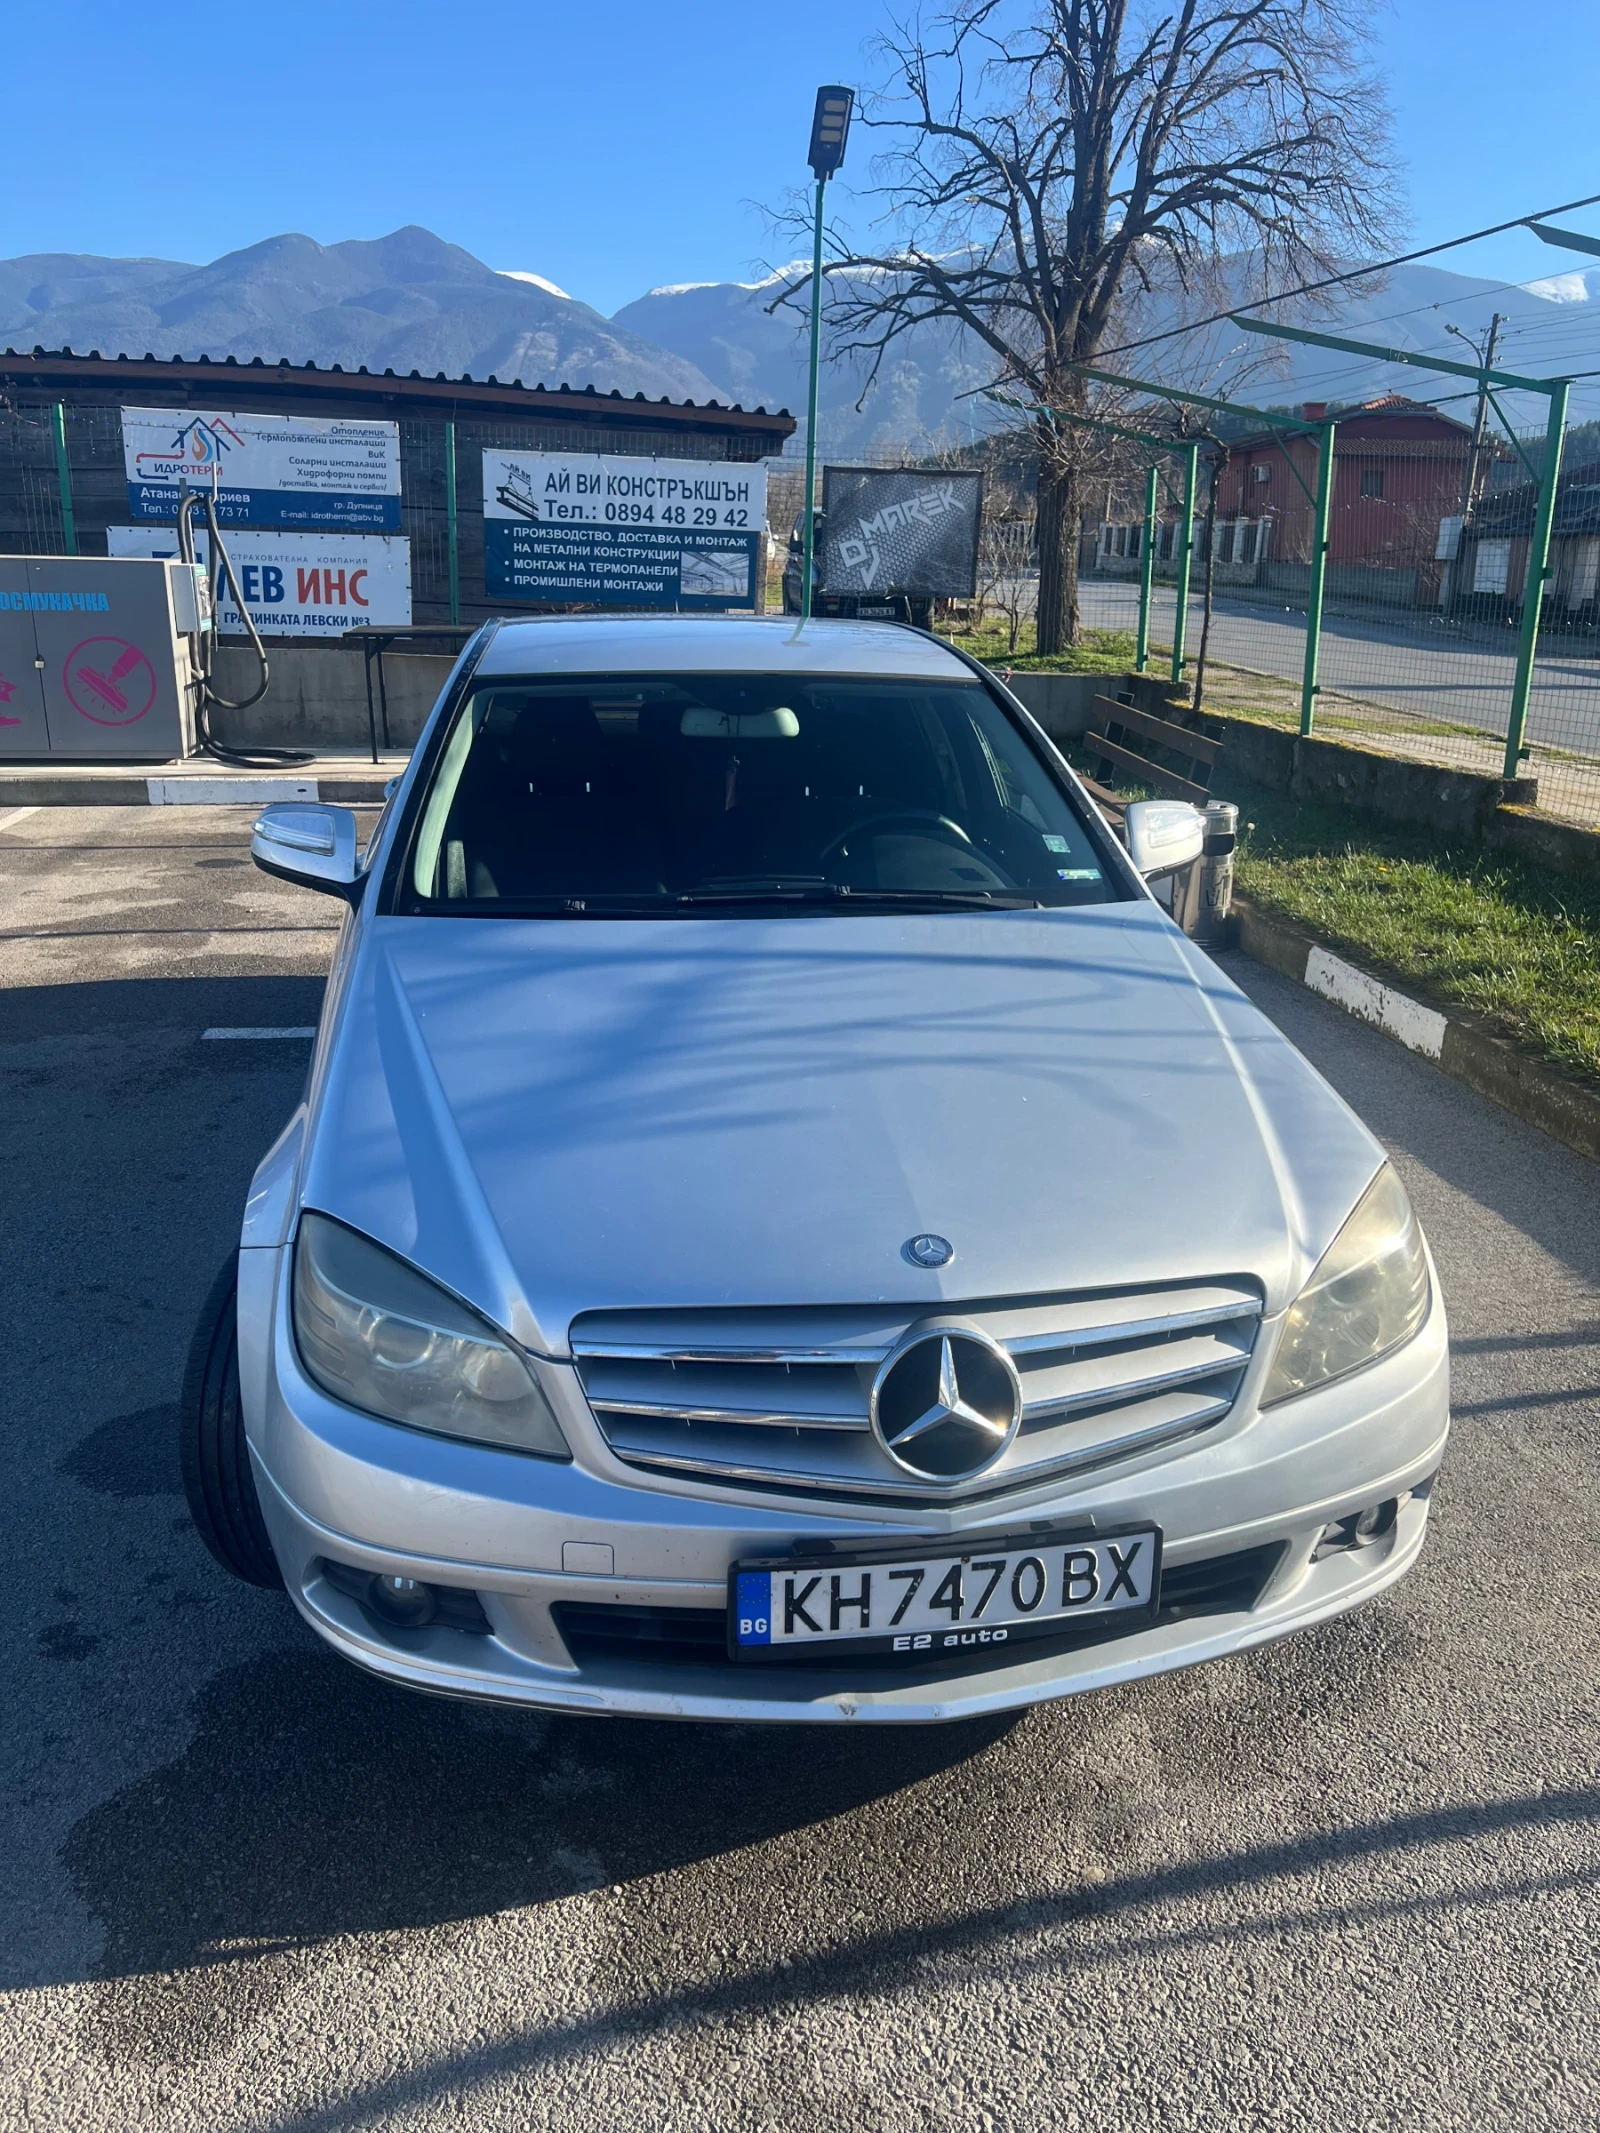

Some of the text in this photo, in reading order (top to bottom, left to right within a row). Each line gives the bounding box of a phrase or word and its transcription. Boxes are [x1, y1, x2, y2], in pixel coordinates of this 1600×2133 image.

[257, 433, 386, 447] Термопомпени инсталации
[368, 450, 386, 459] ВиК
[289, 456, 387, 470] Соларни инсталации
[297, 468, 387, 480] Хидрофорни помпи
[321, 482, 352, 490] монтаж
[544, 468, 749, 503] АЙ ВИ КОНСТРЪКШЪН
[141, 503, 169, 514] Тел.:
[219, 507, 234, 517] 73
[236, 507, 250, 518] 71
[334, 502, 383, 511] гр. Дупница
[544, 499, 748, 528] Тел.: 0894 48 29 42
[857, 480, 967, 539] MAREK
[280, 510, 384, 523] E-mail: idrotherm@abv.bg
[617, 532, 681, 545] ДОСТАВКА
[684, 535, 692, 545] И
[695, 536, 747, 547] МОНТАЖ
[513, 543, 679, 561] НА МЕТАЛНИ КОНСТРУКЦИИ
[317, 557, 368, 565] КОМПАНИЯ
[514, 559, 678, 576] МОНТАЖ НА ТЕРМОПАНЕЛИ
[217, 565, 369, 607] ЛЕВ ИНС
[514, 575, 663, 592] ПРОМИШЛЕНИ МОНТАЖИ
[224, 612, 301, 626] ГРАДИНКАТА
[302, 614, 348, 627] ЛЕВСКИ
[352, 616, 371, 626] №3
[783, 1542, 1144, 1634] KH 7470 BX
[740, 1618, 767, 1634] BG
[893, 1629, 1008, 1651] E2 auto
